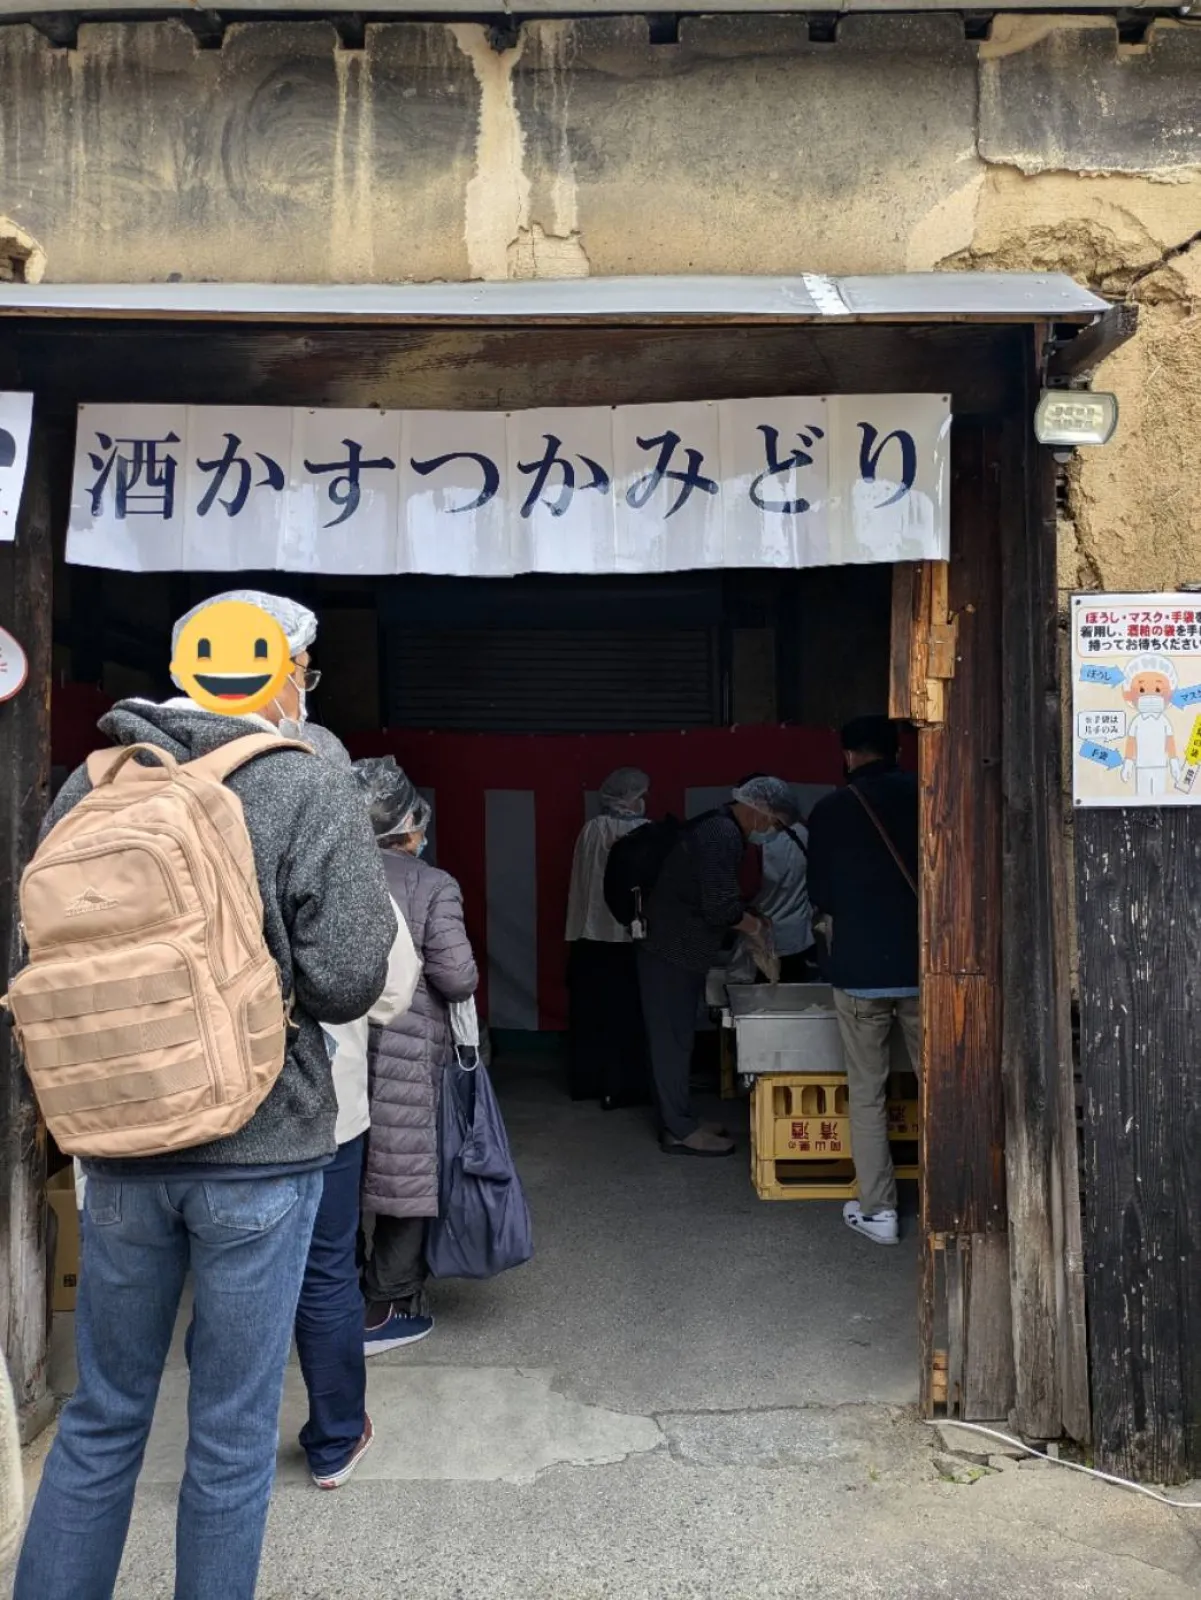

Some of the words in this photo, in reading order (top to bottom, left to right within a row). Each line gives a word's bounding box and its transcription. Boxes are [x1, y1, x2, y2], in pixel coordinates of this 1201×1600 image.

[87, 421, 918, 528] 酒かすつかみどり
[1080, 624, 1201, 638] 着用し、酒粕の袋を手
